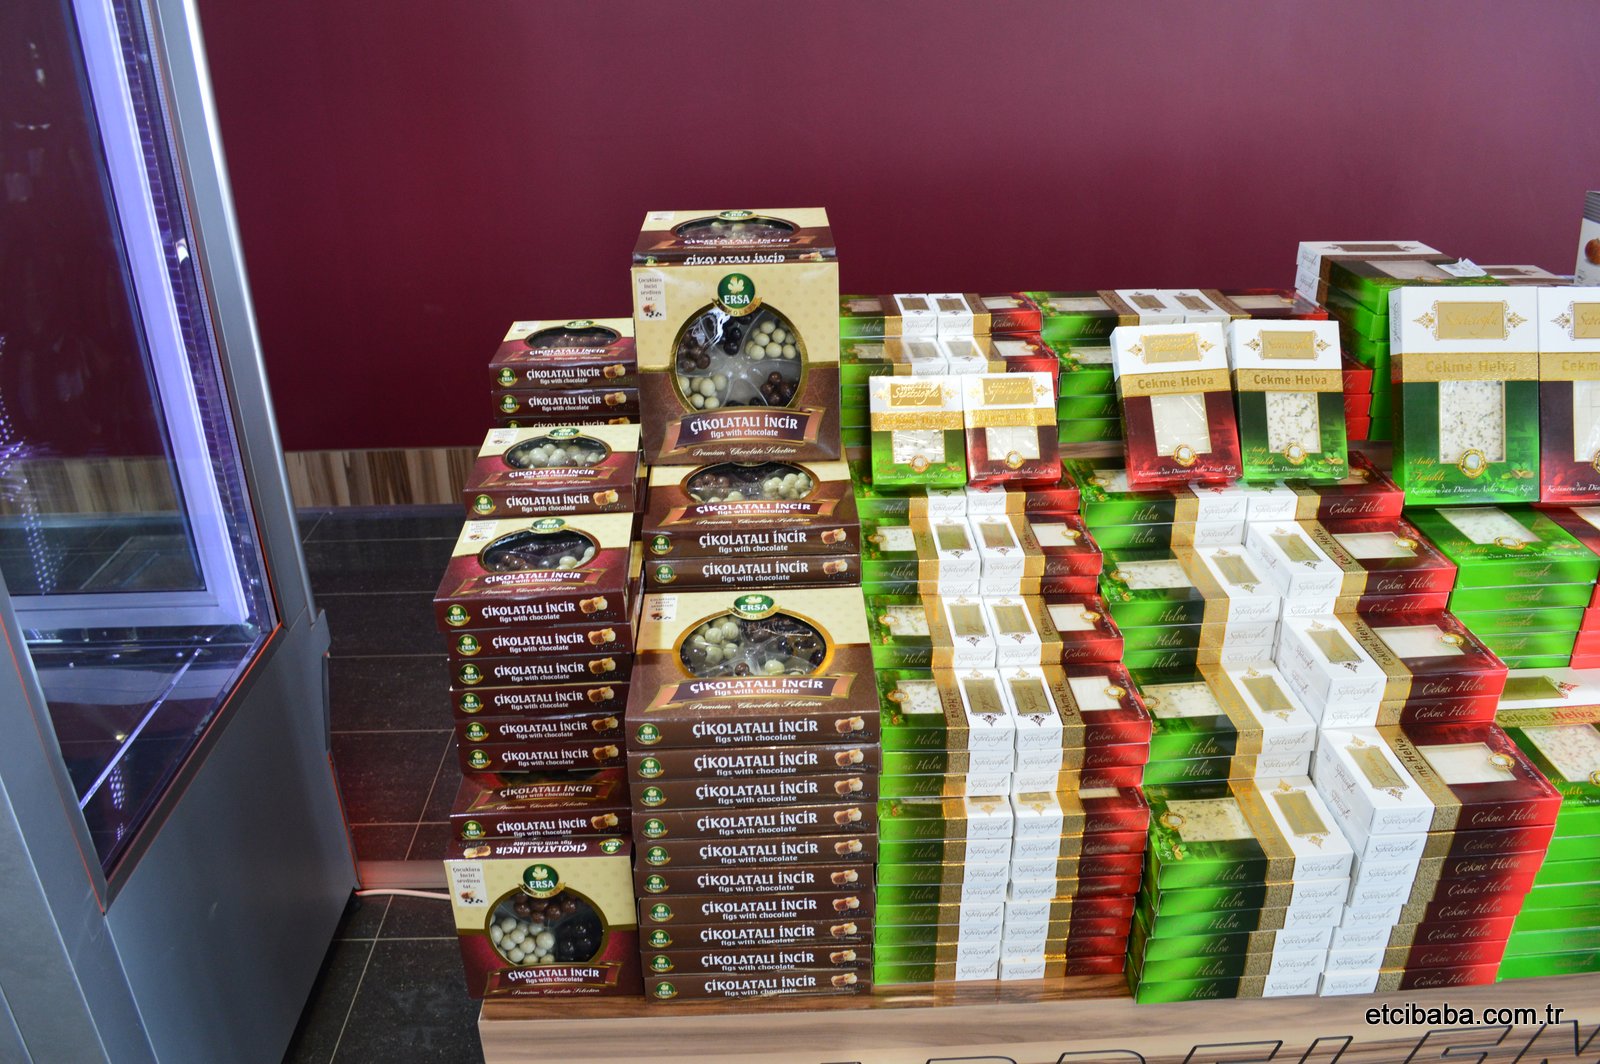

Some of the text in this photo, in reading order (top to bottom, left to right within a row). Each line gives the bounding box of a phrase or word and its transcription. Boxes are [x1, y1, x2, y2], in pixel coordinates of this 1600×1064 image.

[724, 295, 750, 304] ERSA
[1479, 360, 1516, 372] Helva
[527, 369, 600, 380] ÇİKOLATALI İNCİR
[1182, 375, 1214, 386] Helva
[1296, 375, 1327, 385] Helva
[529, 396, 601, 408] ÇİKOLATALI İNCİR
[691, 415, 798, 434] ÇİKOLATALI İNCİR
[711, 429, 724, 438] figs
[744, 428, 778, 436] chocolate
[506, 495, 589, 508] ÇİKOLATALI İNCİR
[696, 502, 810, 513] ÇİKOLATALI İNCİR
[1360, 498, 1384, 512] Helva
[699, 531, 806, 548] ÇİKOLATALI İNCİR
[718, 546, 733, 554] figs
[753, 544, 788, 552] chocolate
[702, 561, 808, 577] ÇİKOLATALI İNCİR
[485, 573, 548, 584] ÇİKOLATALI
[1408, 573, 1436, 589] Helva
[482, 602, 575, 618] ÇİKOLATALI İNCİR
[492, 633, 584, 648] ÇİKOLATALI İNCİR
[494, 663, 584, 678] ÇİKOLATALI İNCİR
[690, 679, 824, 693] ÇİKOLATALI İNCİR
[1456, 675, 1486, 691] Helva
[494, 691, 583, 706] ÇİKOLATALI İNCİR
[1449, 700, 1477, 716] Helva
[1551, 711, 1596, 720] Helva
[500, 721, 588, 735] ÇİKOLATALI İNCİR
[692, 719, 818, 738] ÇİKOLATALI İNCİR
[715, 736, 732, 744] figs
[756, 734, 796, 742] chocolate
[502, 749, 588, 762] ÇİKOLATALI İNCİR
[694, 753, 818, 771] ÇİKOLATALI İNCİR
[500, 786, 560, 797] ÇİKOLATALI
[696, 782, 818, 800] ÇİKOLATALI İNCİR
[1508, 804, 1537, 820] Helva
[497, 817, 586, 832] ÇİKOLATALI İNCİR
[697, 813, 817, 831] ÇİKOLATALI İNCİR
[719, 828, 734, 836] figs
[700, 843, 818, 859] ÇİKOLATALI İNCİR
[1491, 856, 1520, 870] Helva
[698, 872, 814, 888] ÇİKOLATALI İNCİR
[1484, 877, 1512, 892] Helva
[702, 899, 816, 915] ÇİKOLATALI İNCİR
[1473, 898, 1503, 914] Helva
[700, 926, 814, 942] ÇİKOLATALI İNCİR
[1463, 922, 1492, 937] Helva
[701, 952, 814, 967] ÇİKOLATALI İNCİR
[508, 968, 599, 981] ÇİKOLATALI İNCİR
[704, 976, 816, 993] ÇİKOLATALI İNCİR
